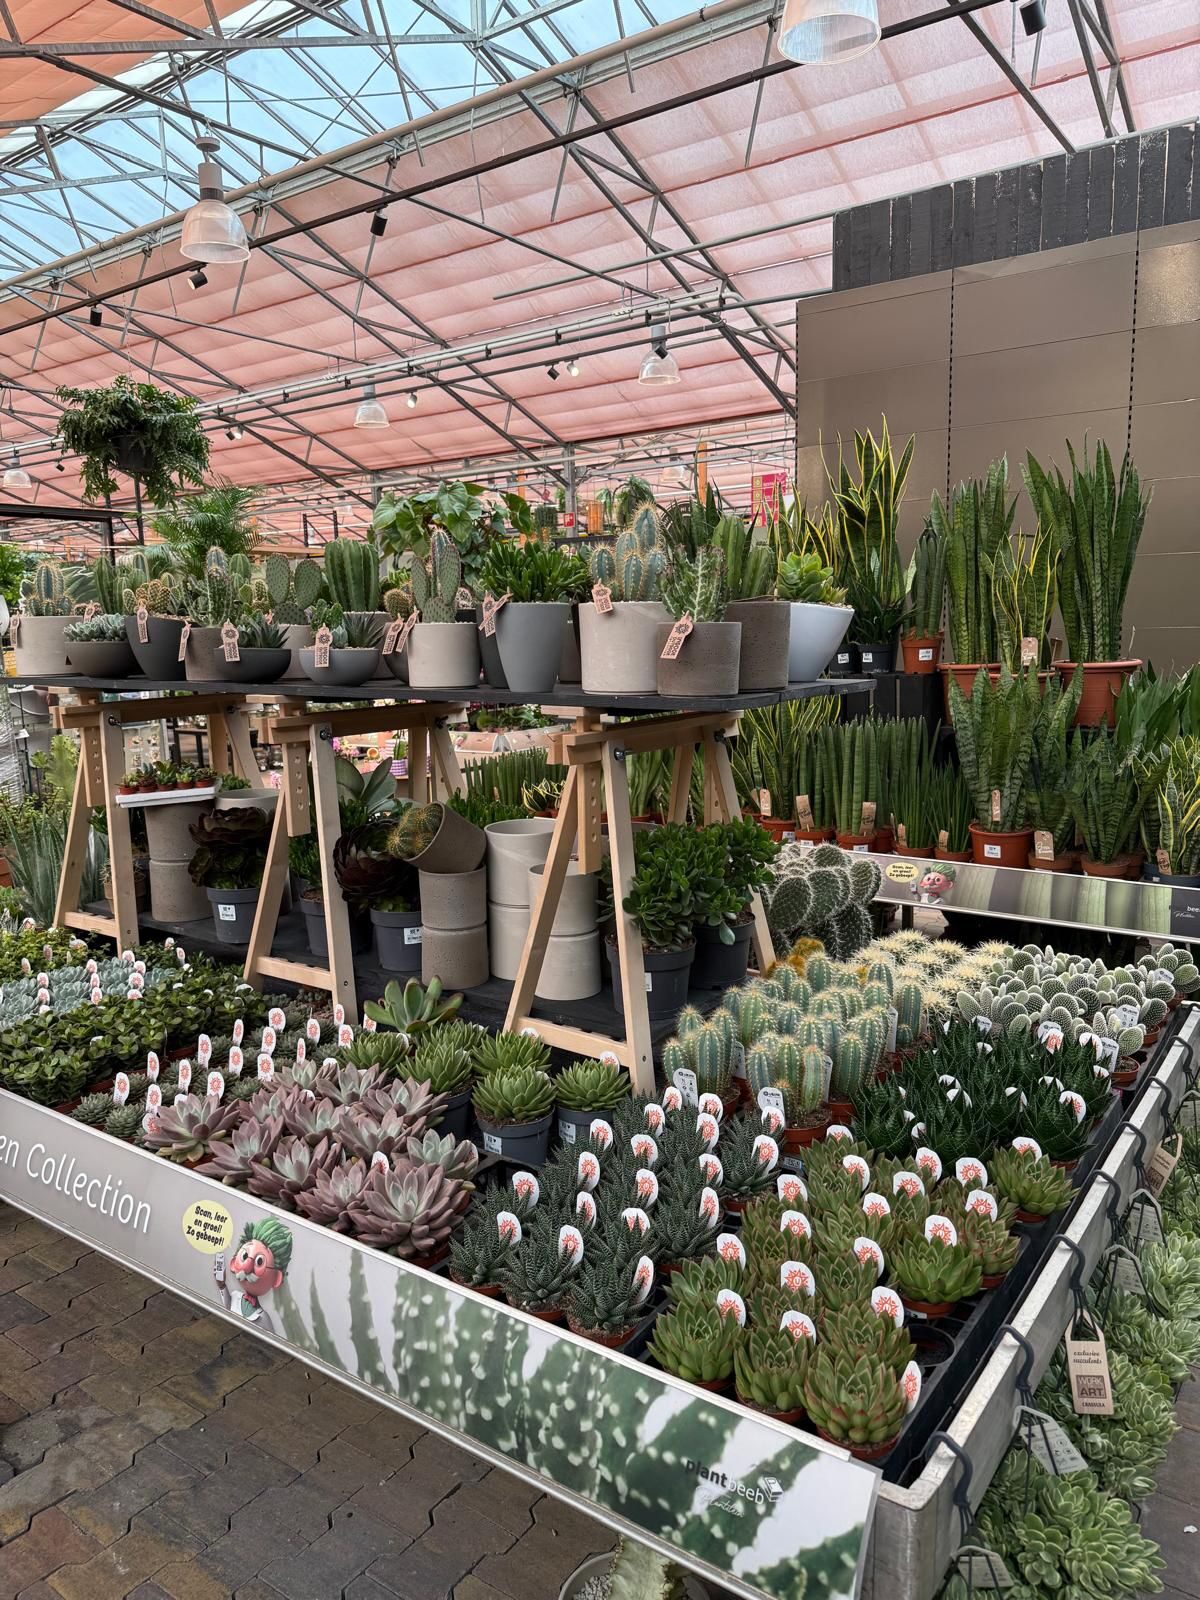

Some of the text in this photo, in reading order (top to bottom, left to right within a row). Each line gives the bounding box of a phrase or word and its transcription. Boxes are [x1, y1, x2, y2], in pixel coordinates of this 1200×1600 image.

[26, 1143, 152, 1233] Collection
[193, 1218, 203, 1227] en
[194, 1205, 228, 1223] Scan, leer
[186, 1225, 225, 1246] Zo gebeept!
[1077, 1376, 1103, 1385] WORK
